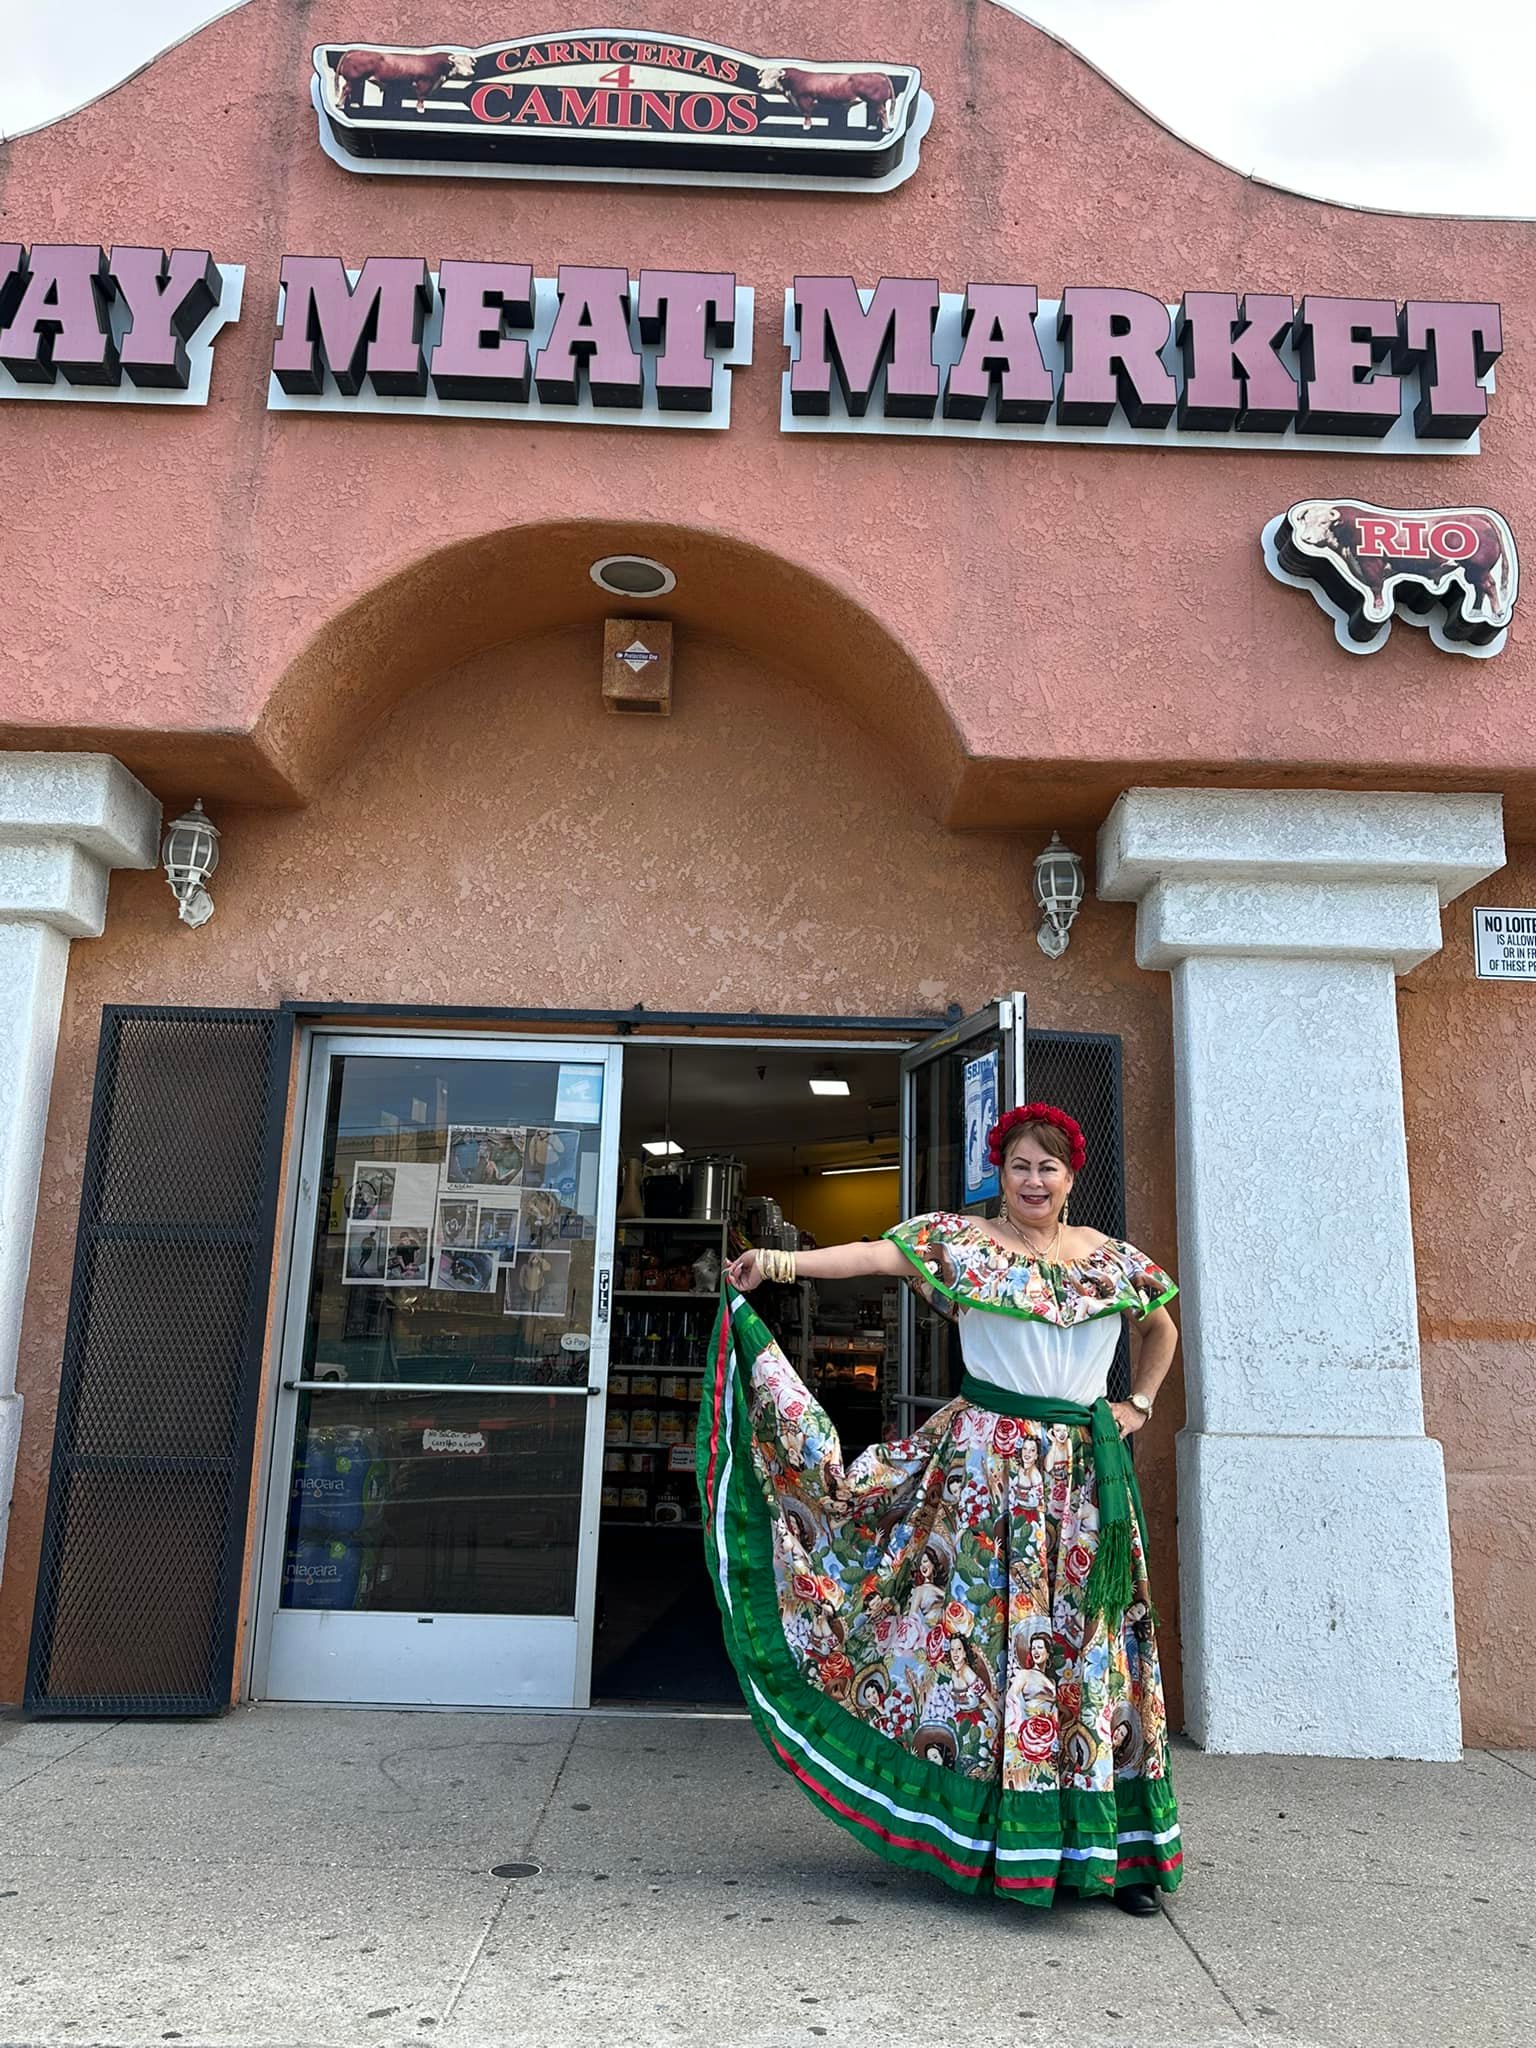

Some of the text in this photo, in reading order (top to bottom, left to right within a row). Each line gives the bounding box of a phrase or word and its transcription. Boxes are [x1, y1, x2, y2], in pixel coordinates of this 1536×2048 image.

[496, 40, 740, 82] CARNICERIAS
[598, 64, 634, 89] 4
[470, 84, 759, 134] CAMINOS
[272, 255, 736, 388] MEAT
[790, 276, 1502, 416] MARKET
[1355, 518, 1480, 560] RIO
[1484, 915, 1502, 932] NO
[1497, 934, 1536, 946] IS ALLOW
[1503, 947, 1515, 959] OR
[1517, 948, 1525, 959] IN
[1489, 959, 1499, 971] OF
[1501, 959, 1526, 972] THESE
[600, 1273, 608, 1309] PULL
[294, 1478, 345, 1492] niagara
[286, 1564, 337, 1579] niagara
